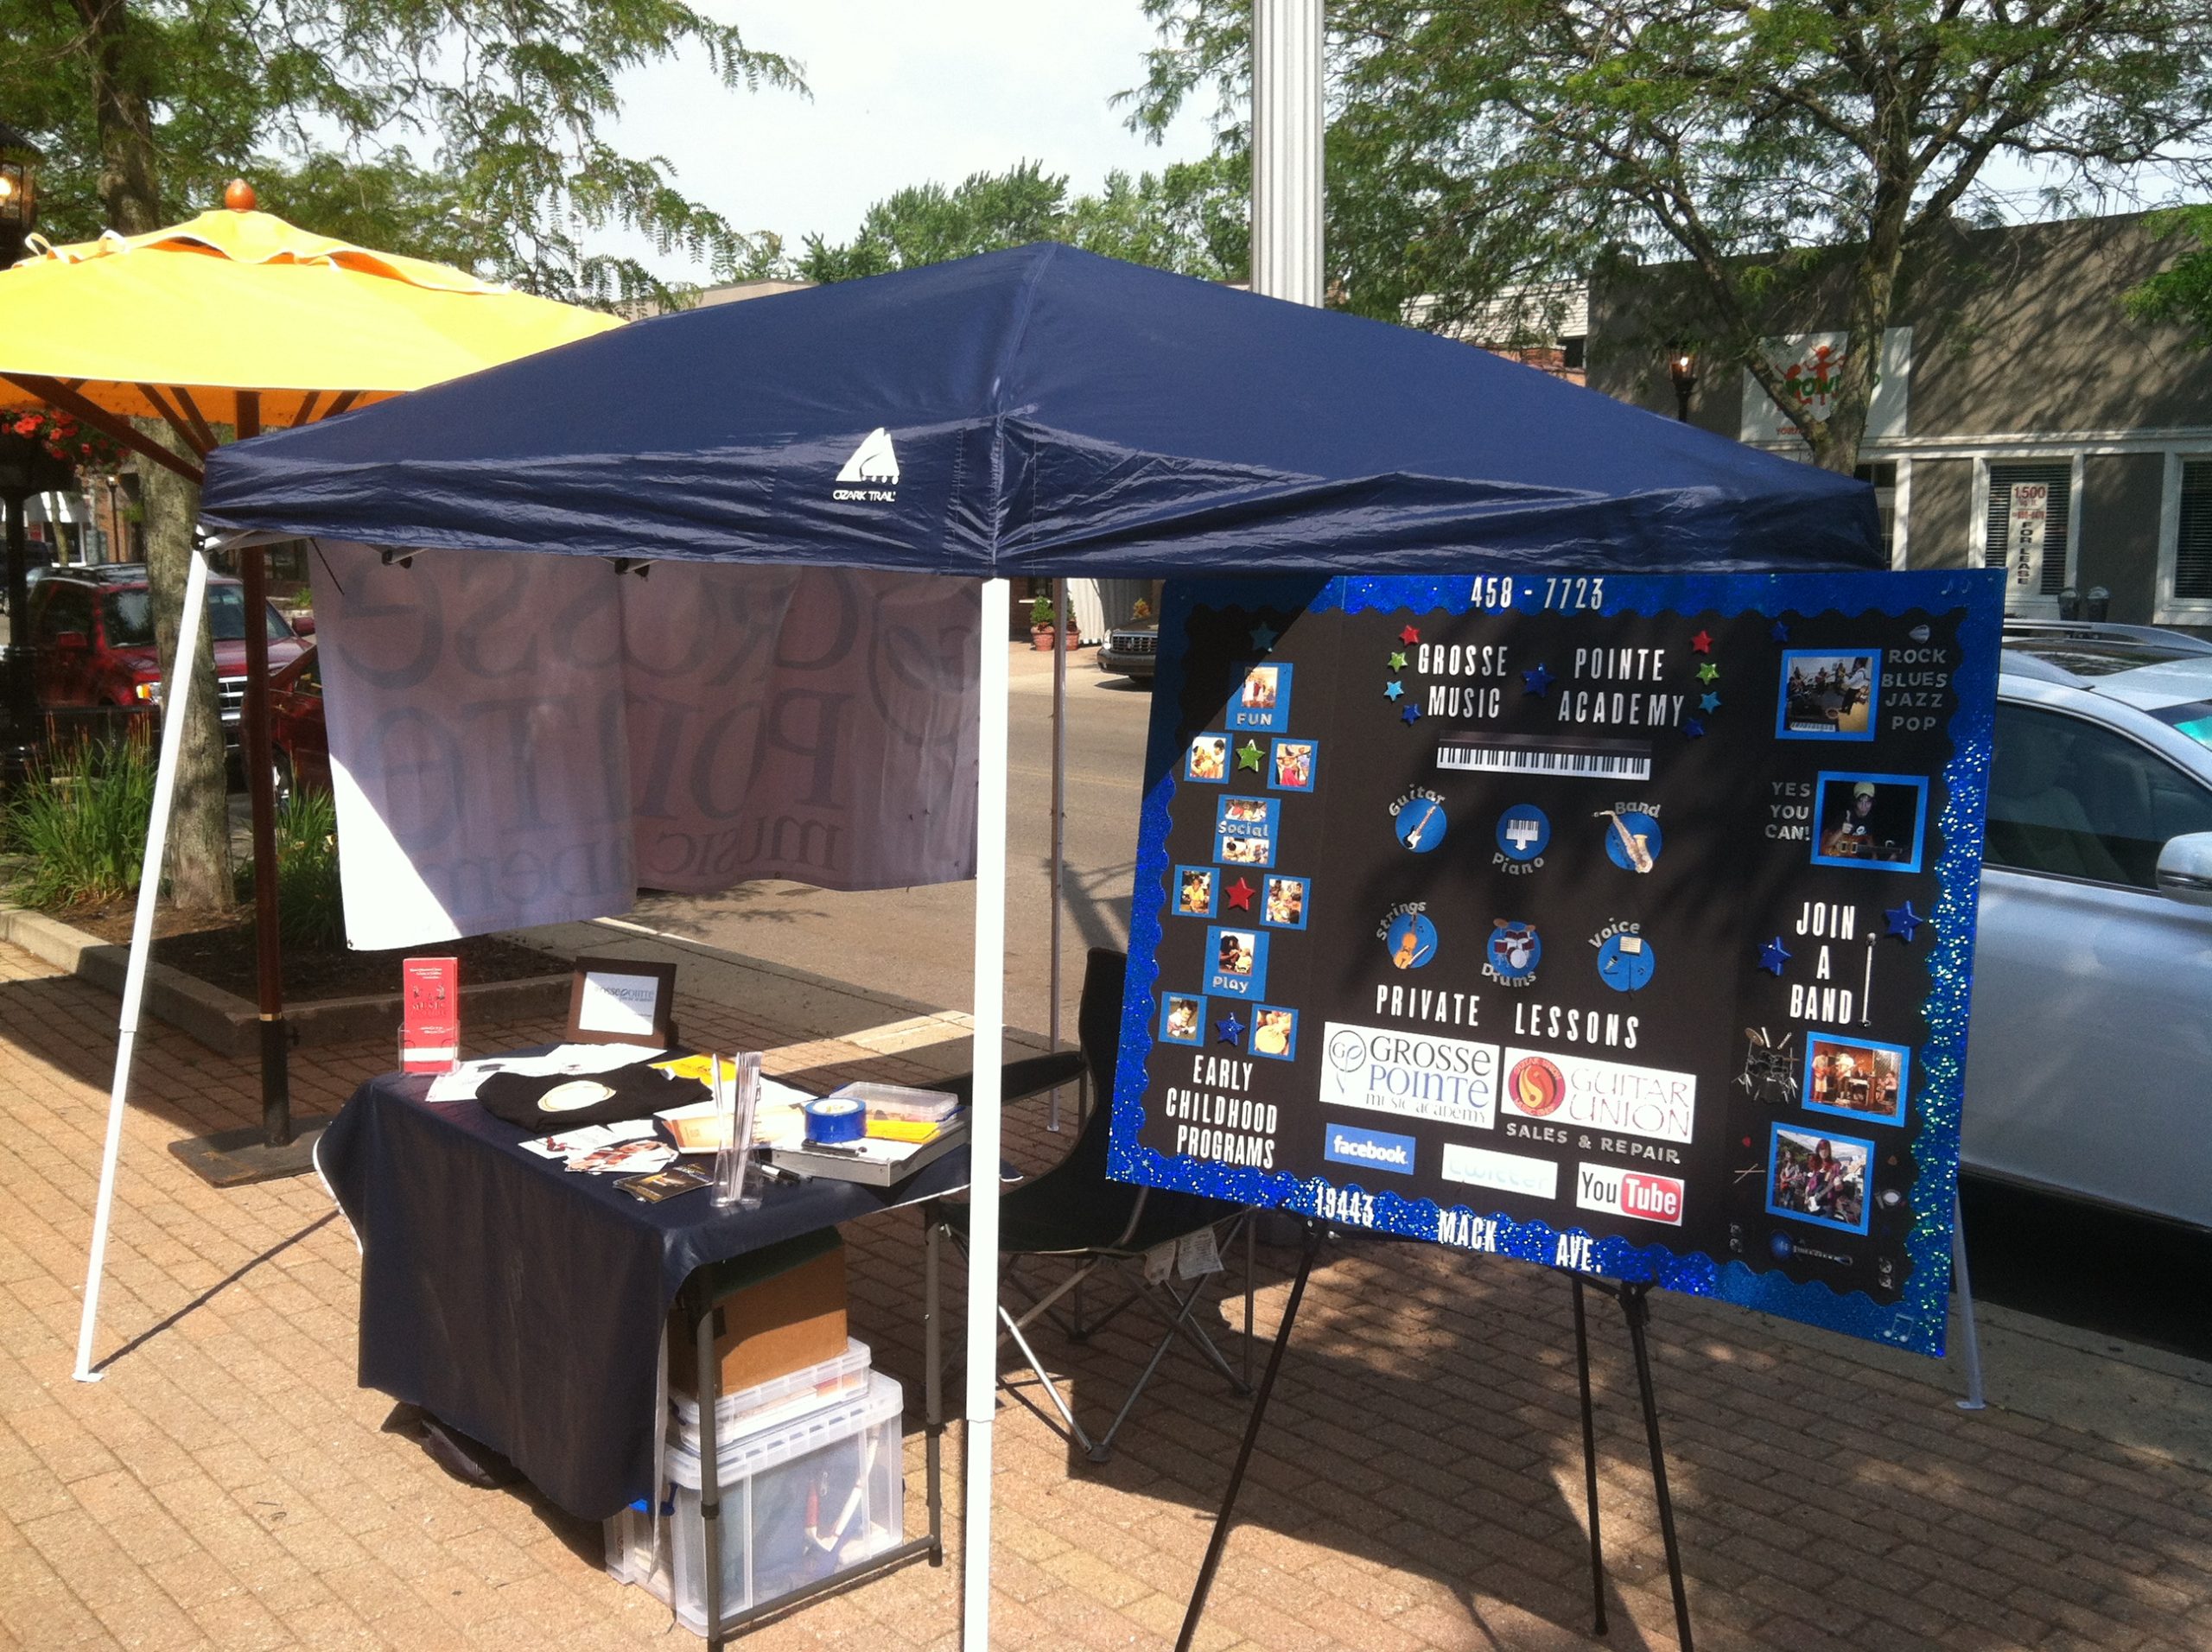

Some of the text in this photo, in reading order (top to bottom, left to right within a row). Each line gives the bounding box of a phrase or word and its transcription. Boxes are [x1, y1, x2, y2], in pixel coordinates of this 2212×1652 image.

[832, 490, 895, 502] OZARK TRAIL
[2019, 522, 2033, 543] FOR
[2018, 548, 2030, 584] LEASE
[1471, 576, 1512, 608] 458
[1543, 577, 1604, 610] 7723
[1418, 644, 1665, 681] GROSSE POINTE
[1888, 649, 1946, 664] ROCK
[1882, 671, 1948, 688] BLUES
[1427, 686, 1684, 727] MUSIC ACADEMY
[1885, 693, 1943, 708] JAZZ
[1236, 712, 1272, 727] FUN
[1891, 716, 1936, 731] POP
[1389, 784, 1446, 817] Guitar
[1771, 781, 1811, 797] YES
[1615, 801, 1661, 818] Band
[1770, 804, 1808, 820] YOU
[1218, 821, 1268, 838] Social
[1764, 824, 1810, 841] CAN!
[1492, 852, 1544, 875] Piano
[1376, 901, 1426, 940] Strings
[1588, 918, 1640, 949] Voice
[1796, 901, 1855, 940] JOIN
[1481, 963, 1536, 987] Drums
[1816, 945, 1830, 980] A
[1212, 975, 1249, 994] Play
[1376, 984, 1639, 1049] PRIVATE LESSONS
[1789, 984, 1852, 1024] BAND
[1193, 1055, 1253, 1091] EARLY
[1570, 1067, 1688, 1109] GUITAR
[1166, 1088, 1278, 1134] CHILDHOOD
[1569, 1093, 1689, 1137] UNION
[1176, 1125, 1275, 1169] PROGRAMS
[1333, 1134, 1408, 1165] facebook
[1506, 1122, 1681, 1165] SALES & REPAIR
[1315, 1185, 1375, 1228] 19443
[1438, 1209, 1497, 1253] MACK
